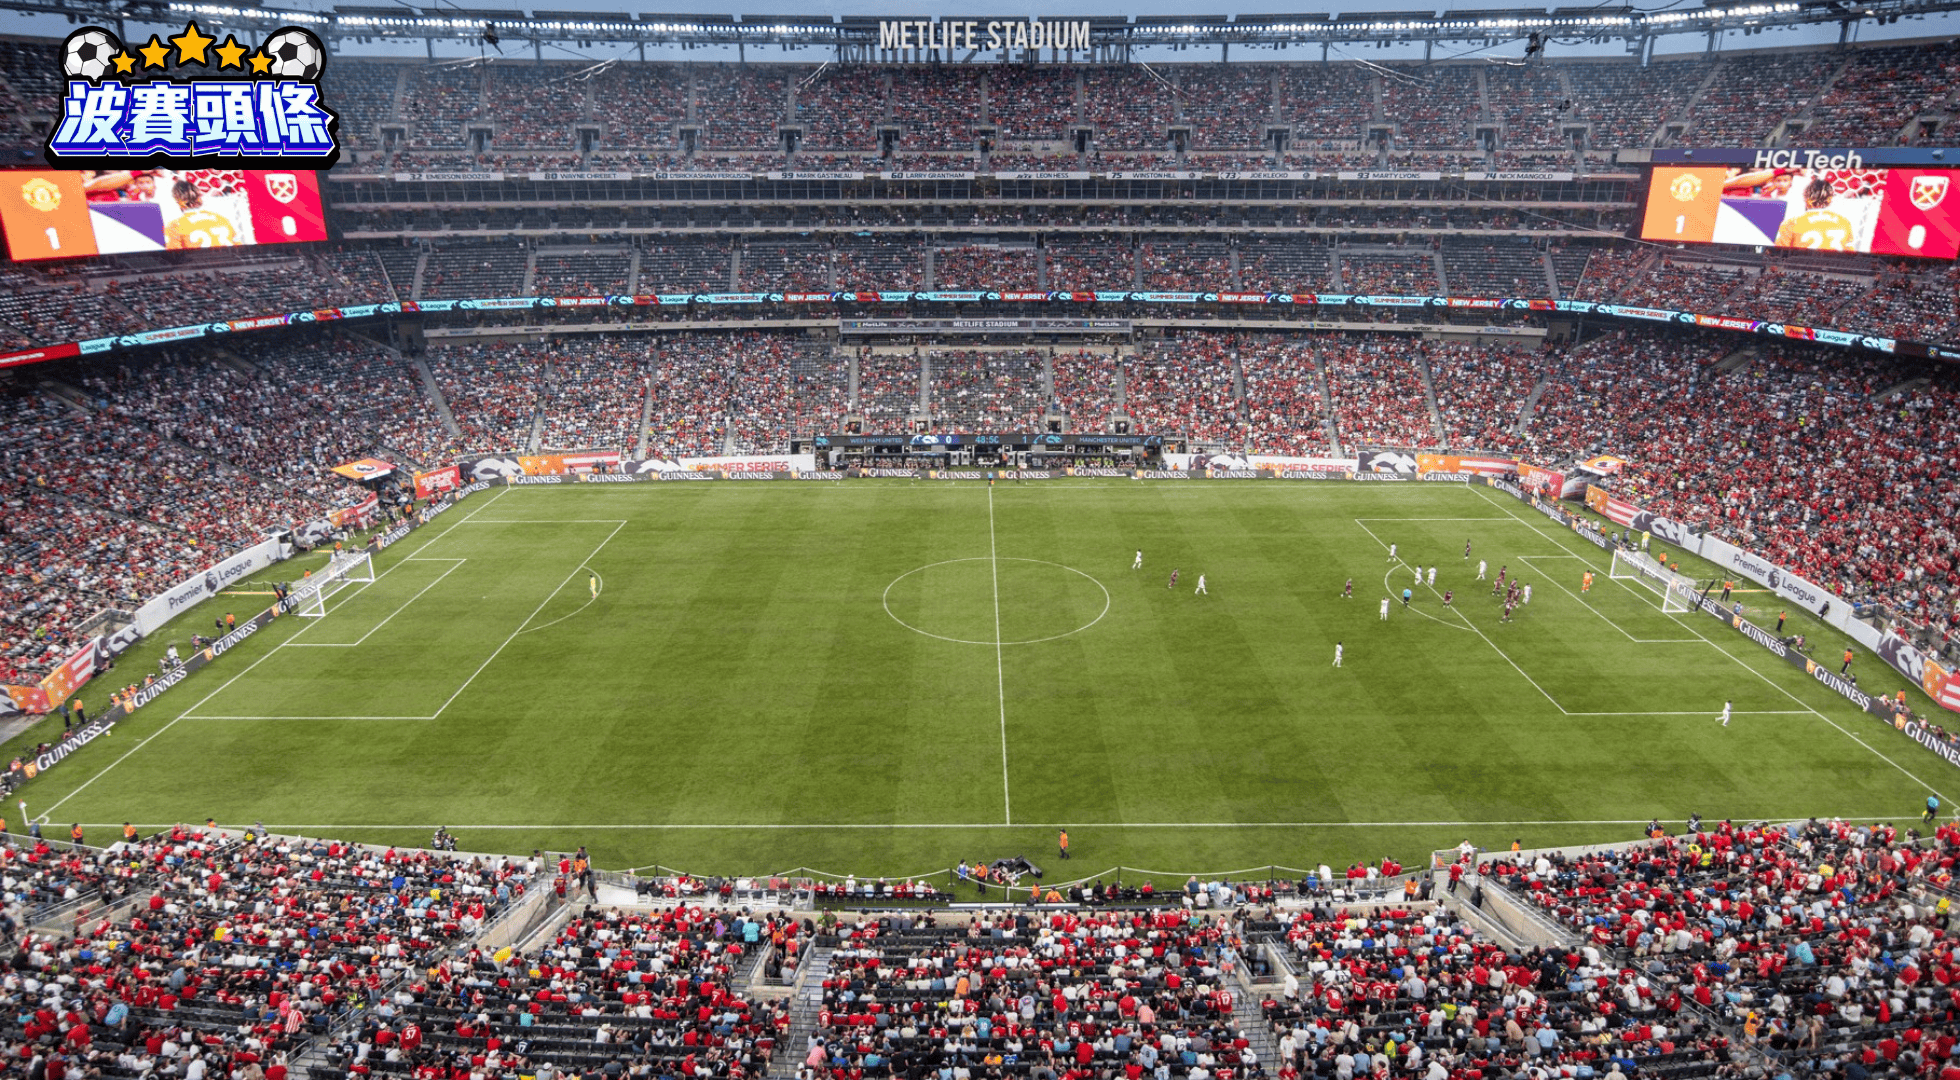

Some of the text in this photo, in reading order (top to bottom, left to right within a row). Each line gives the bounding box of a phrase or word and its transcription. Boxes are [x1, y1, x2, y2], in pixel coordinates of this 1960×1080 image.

[879, 20, 1090, 50] METLIFE STADIUM
[1754, 149, 1863, 169] HCLTech
[1675, 214, 1685, 234] 1
[45, 226, 60, 250] 1
[578, 297, 605, 305] JERSEY
[1470, 300, 1499, 308] JERSEY
[1617, 308, 1668, 319] SUMMER SERIES
[234, 317, 286, 330] NEW JERSEY
[1700, 317, 1752, 330] NEW JERSEY
[1822, 333, 1848, 342] League
[945, 436, 952, 444] 0
[687, 461, 789, 472] SMMER SERIES
[1310, 464, 1352, 472] SERIES
[658, 471, 704, 480] GUINNESS
[728, 471, 773, 479] GUINNESS
[797, 471, 843, 480] GUINNESS
[868, 468, 912, 477] GUINNESS
[937, 471, 981, 479] GUINNESS
[1073, 468, 1118, 477] GUINNESS
[1144, 471, 1188, 479] GUINNESS
[1213, 471, 1257, 479] GUINNESS
[1282, 471, 1327, 479] GUINNESS
[1353, 473, 1398, 481] GUINNESS
[1528, 469, 1551, 481] NEW
[515, 475, 562, 484] GUINNESS
[587, 474, 633, 482] GUINNESS
[1423, 474, 1469, 482] GUINNESS
[1576, 523, 1606, 548] GUINNESS
[167, 557, 252, 609] Premier League
[1732, 553, 1816, 604] Premier League
[213, 621, 258, 656] GUINNESS
[1739, 619, 1786, 657] GUINNESS
[133, 666, 188, 708] GUINNESS
[1814, 666, 1871, 711] GUINNESS
[36, 720, 103, 771] GUINNESS
